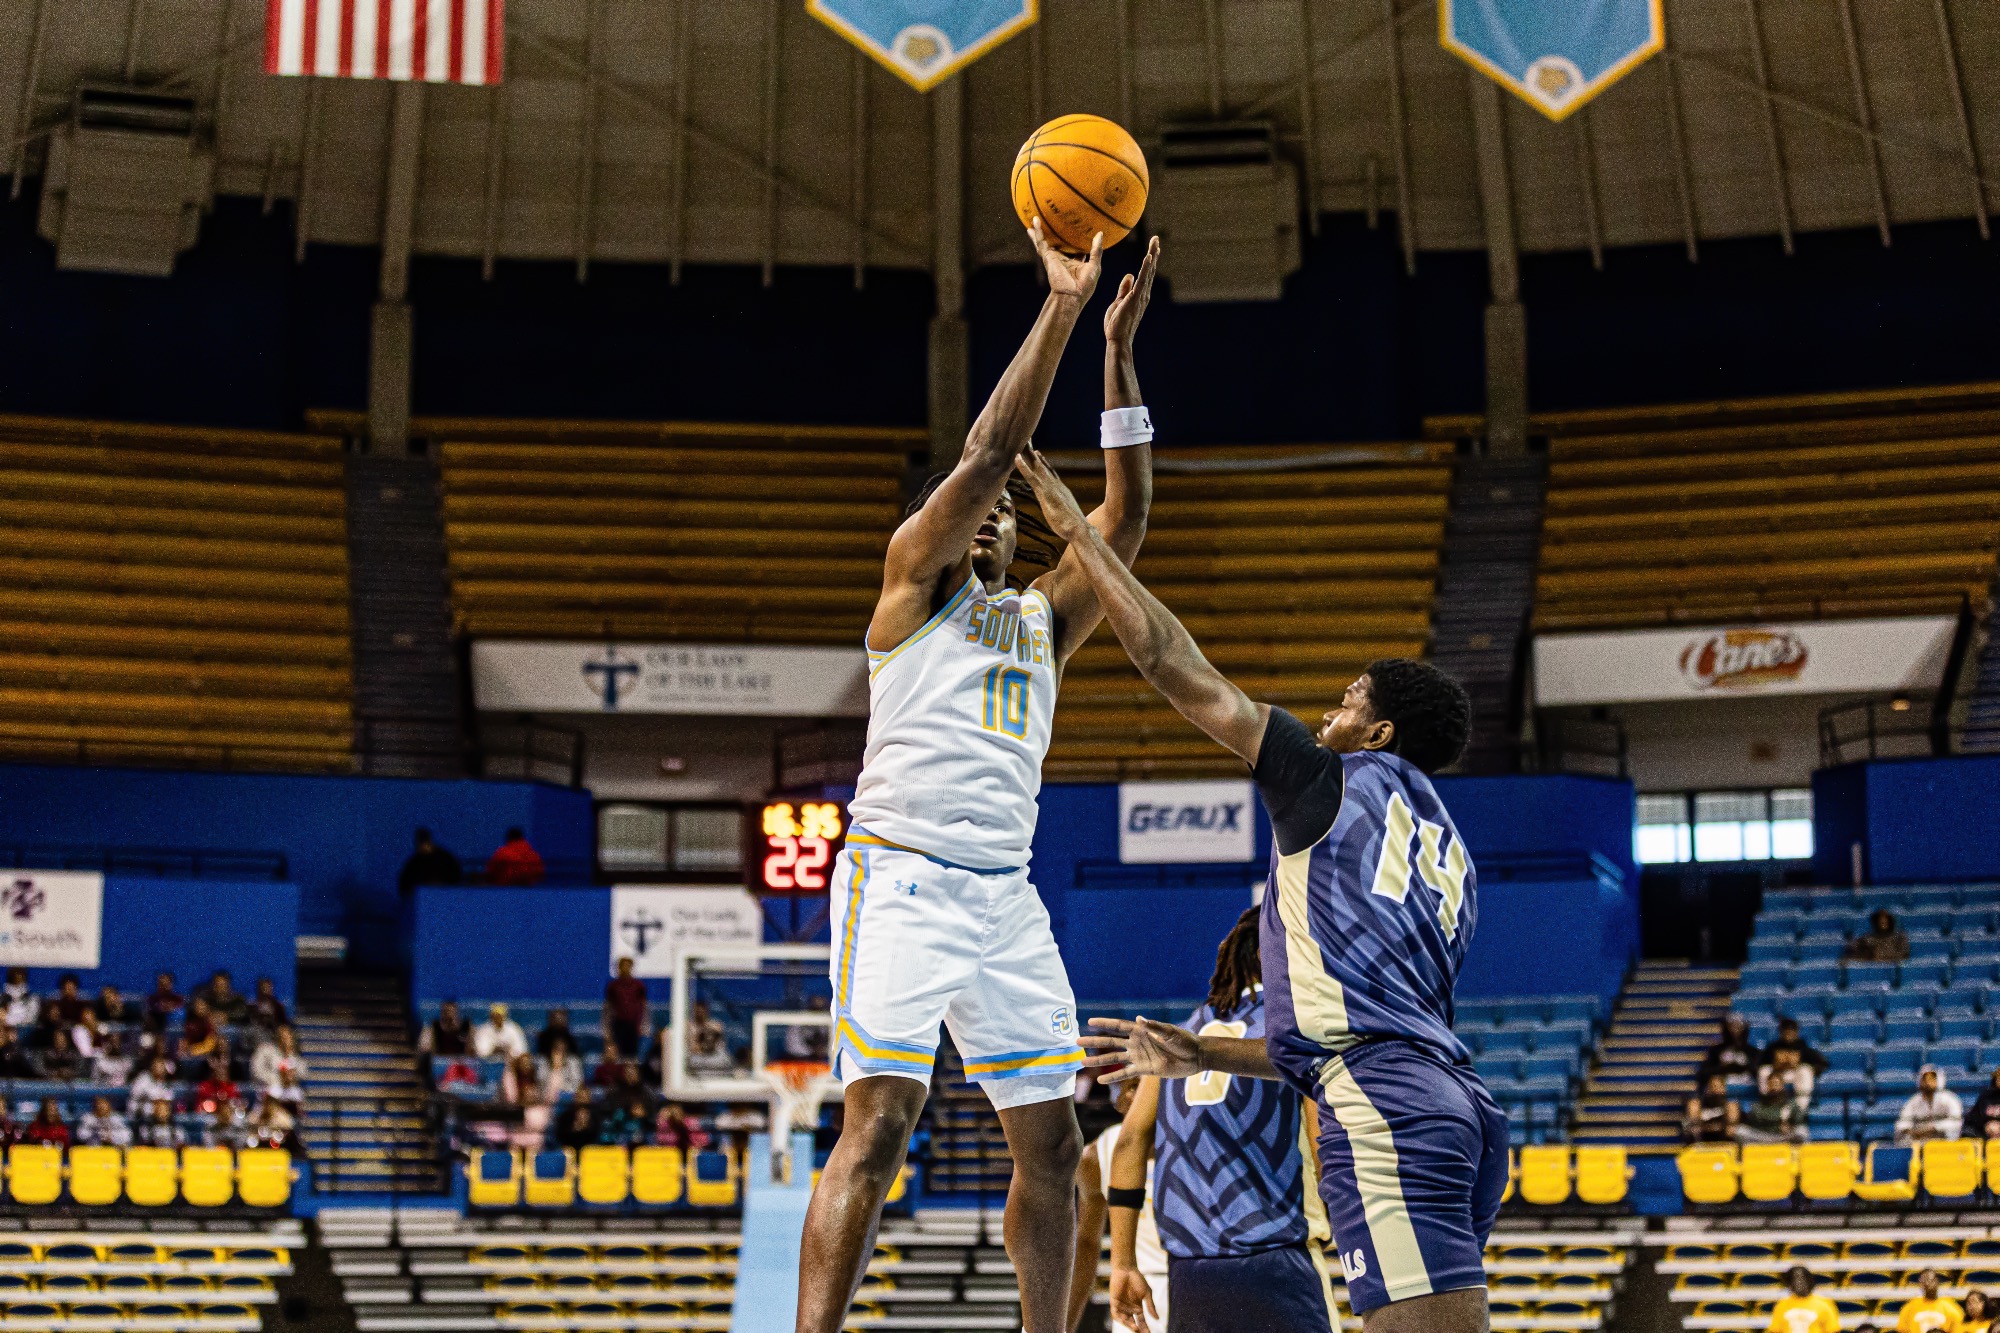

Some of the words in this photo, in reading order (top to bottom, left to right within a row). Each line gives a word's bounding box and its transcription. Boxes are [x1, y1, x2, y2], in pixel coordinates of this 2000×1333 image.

[983, 663, 1032, 741] 10
[1128, 802, 1243, 833] GEAUX
[764, 836, 829, 889] 22
[1371, 791, 1468, 946] 14
